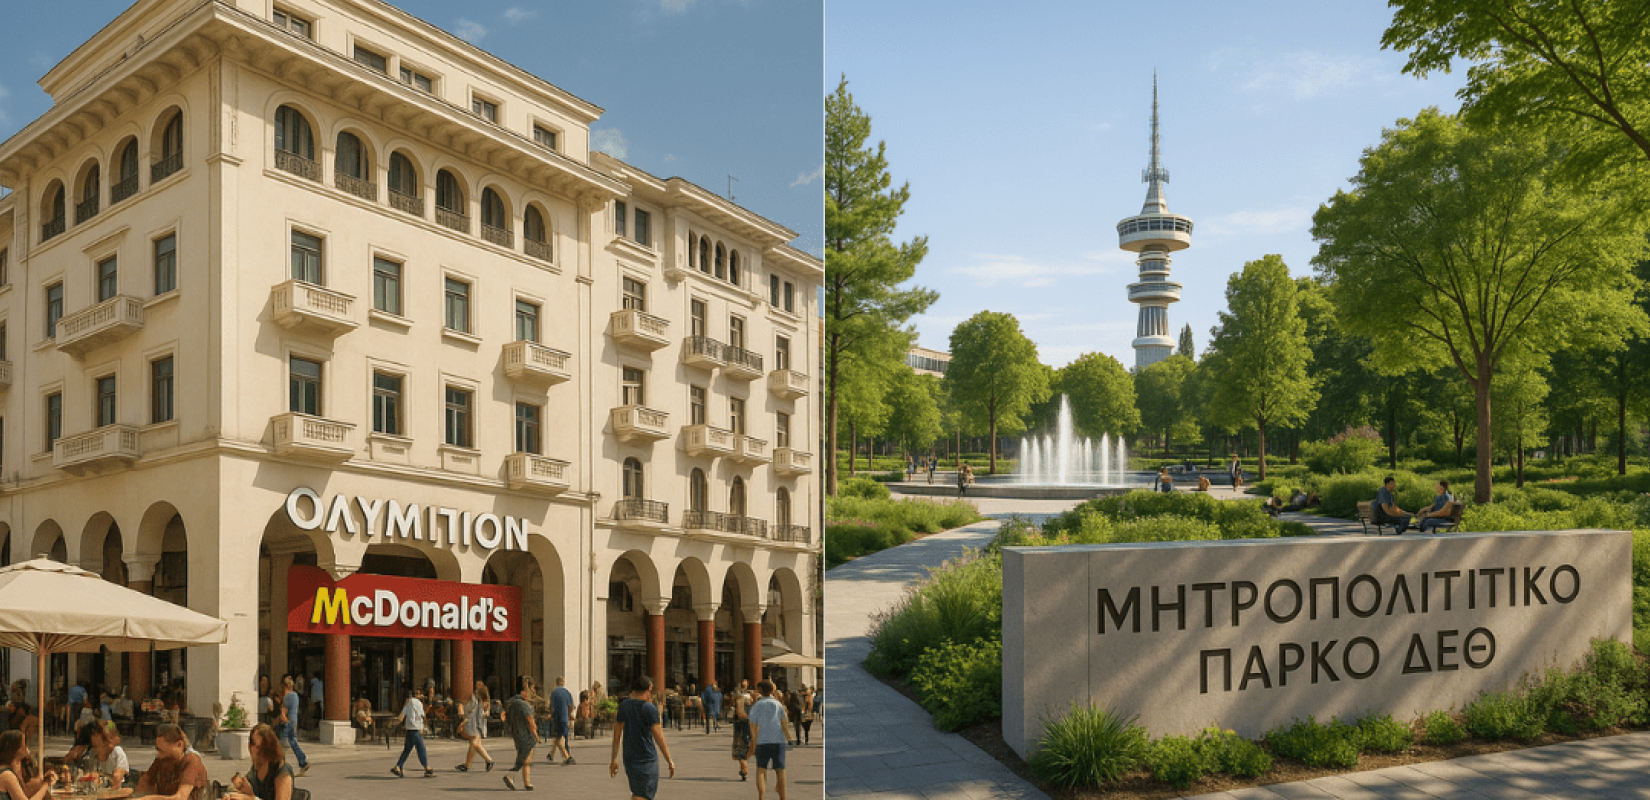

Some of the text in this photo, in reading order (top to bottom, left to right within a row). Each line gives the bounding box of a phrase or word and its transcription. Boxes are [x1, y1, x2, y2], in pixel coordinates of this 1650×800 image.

[311, 586, 509, 632] McDonald's
[1096, 564, 1581, 634] ΜΗΤΡΟΠΟΛΙΤΙΤΙΚΟ
[1199, 626, 1497, 694] ΠΑΡΚΟ ΔΕΘ
